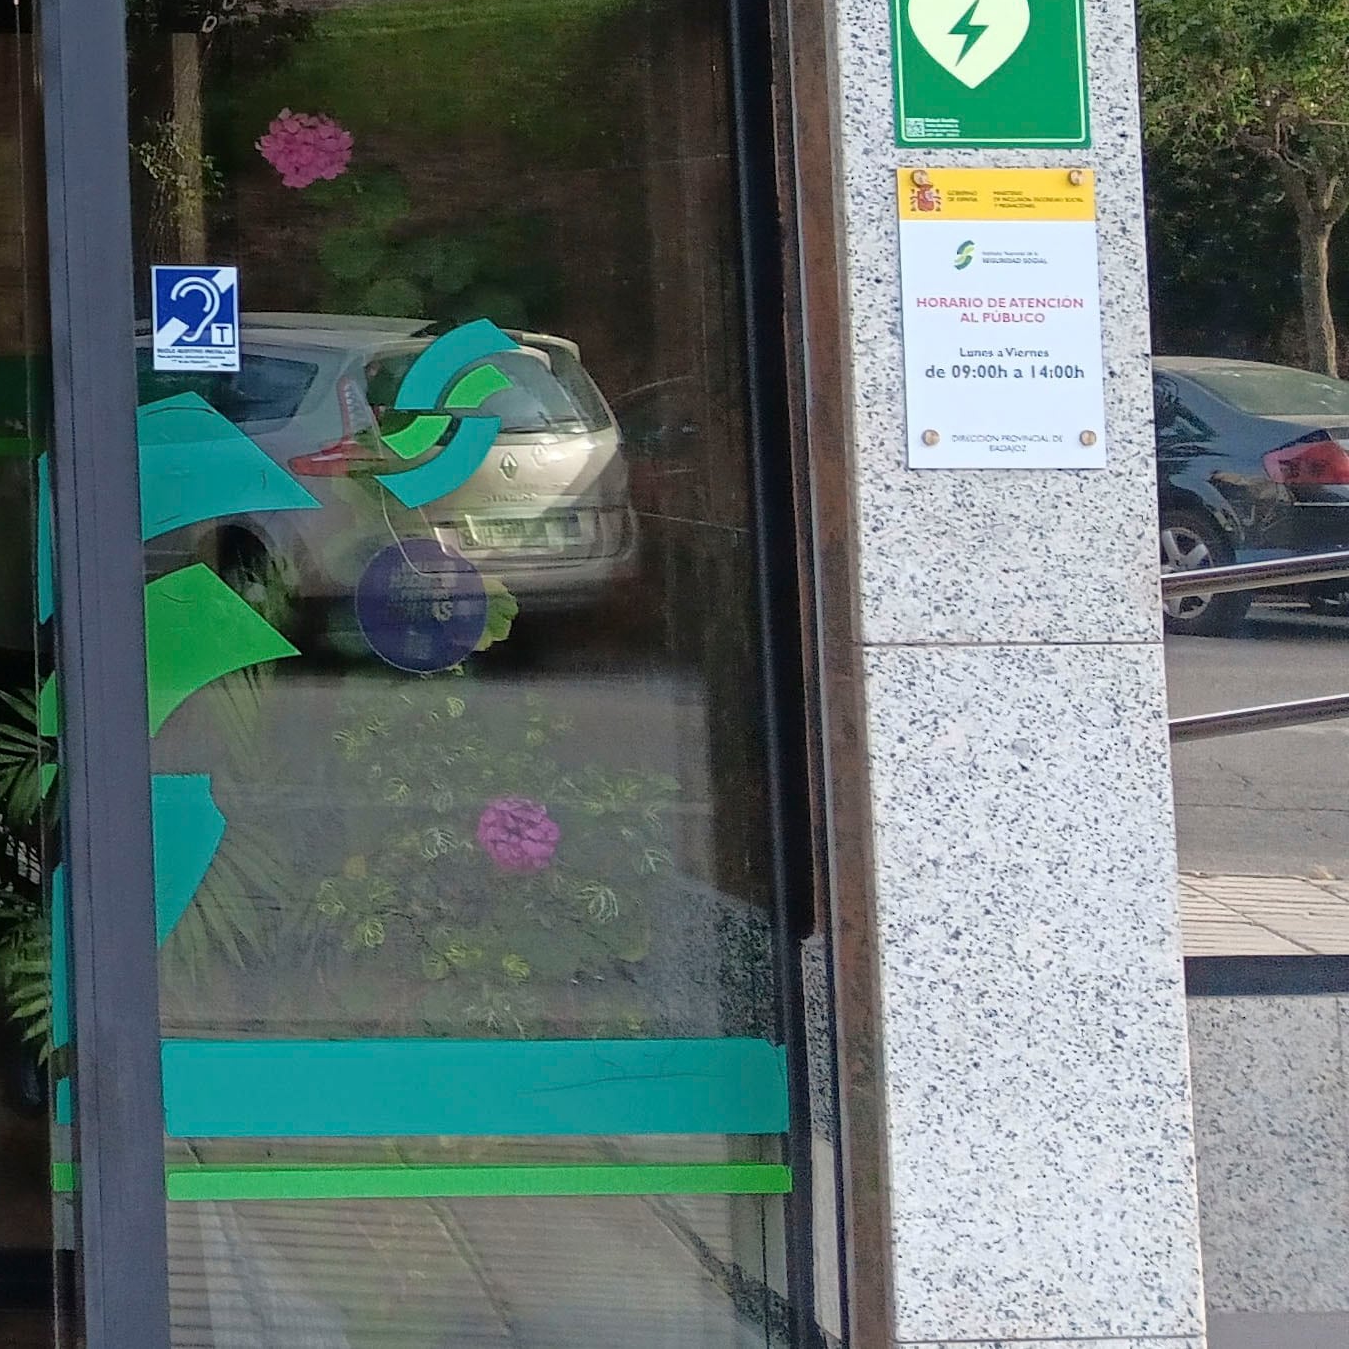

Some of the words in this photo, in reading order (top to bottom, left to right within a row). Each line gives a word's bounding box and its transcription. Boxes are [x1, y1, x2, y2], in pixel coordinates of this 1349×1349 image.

[916, 297, 984, 308] HORARIO
[987, 297, 1007, 308] DE
[1009, 295, 1084, 308] ATENCIÓN
[960, 312, 979, 323] AL
[983, 310, 1046, 324] PÚBLICO
[215, 325, 229, 343] T
[959, 347, 993, 358] Lunes
[1005, 347, 1050, 358] Viernes
[925, 365, 946, 379] de
[952, 365, 1008, 379] 09:00h
[1013, 368, 1024, 379] a
[1030, 365, 1085, 379] 14:00h
